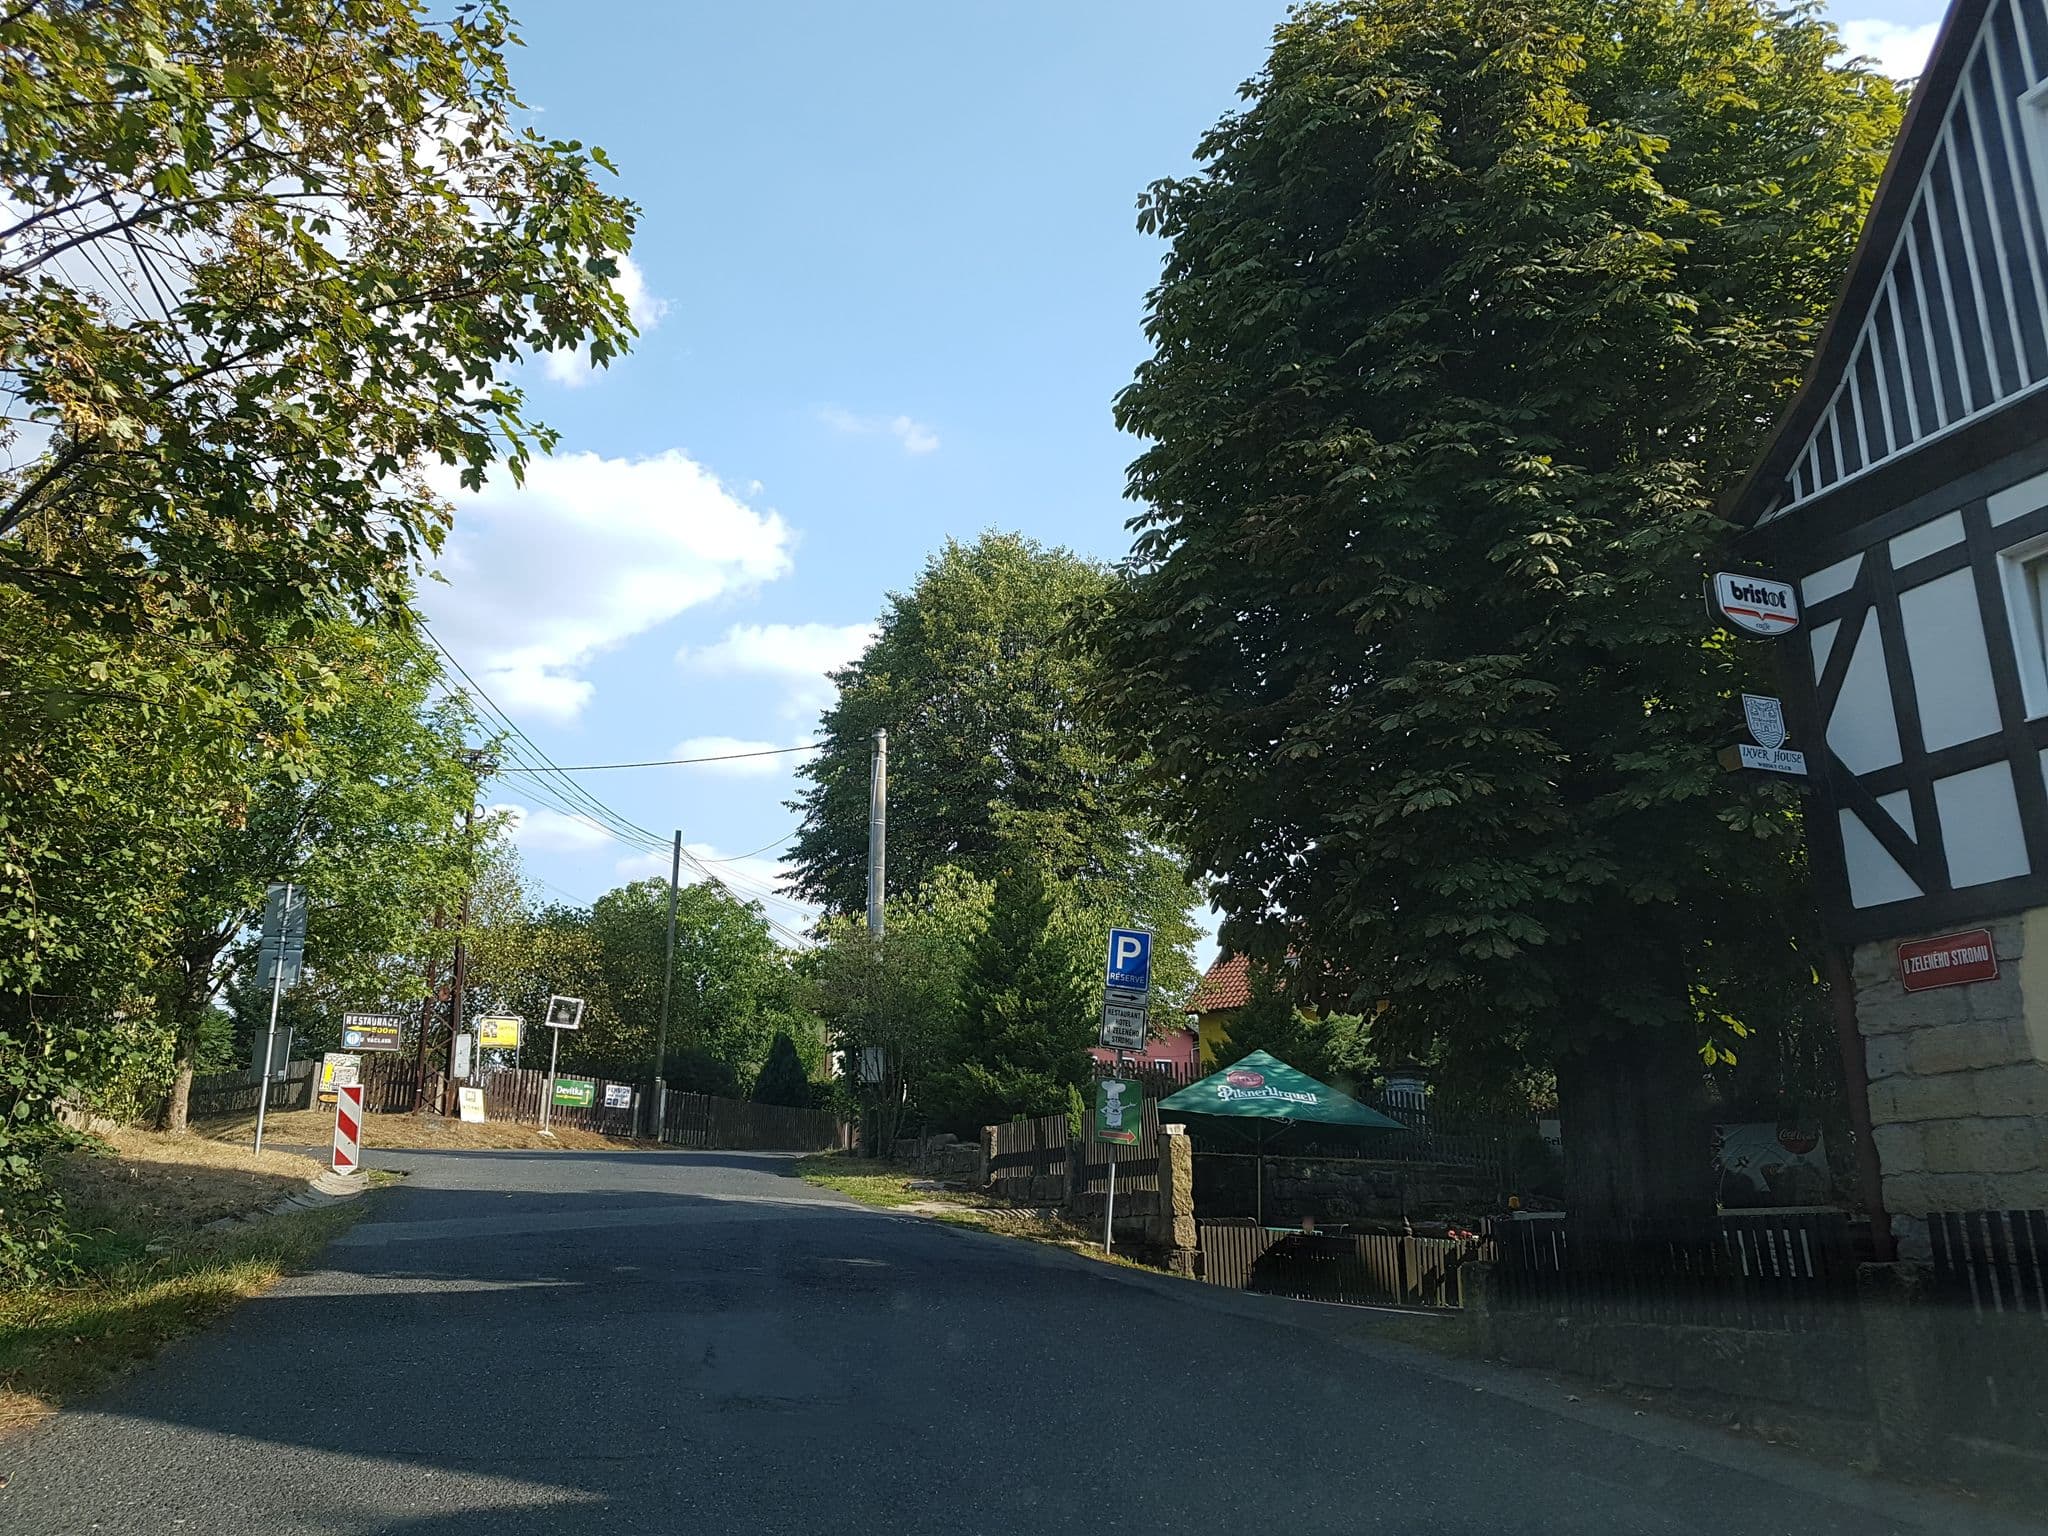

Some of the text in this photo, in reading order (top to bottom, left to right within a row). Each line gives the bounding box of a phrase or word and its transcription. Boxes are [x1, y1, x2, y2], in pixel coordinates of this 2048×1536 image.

[1730, 581, 1786, 608] bristot
[1742, 747, 1802, 763] INVER HOUSE
[1116, 936, 1142, 969] P
[1903, 945, 1989, 975] U ZELENÉHO STROMU
[346, 1015, 398, 1027] RESTAURACE
[1107, 1008, 1141, 1019] RESTAURANT
[371, 1026, 398, 1034] 500m
[1115, 1019, 1132, 1027] HOTEL
[1217, 1085, 1318, 1103] Pilsner Urquell
